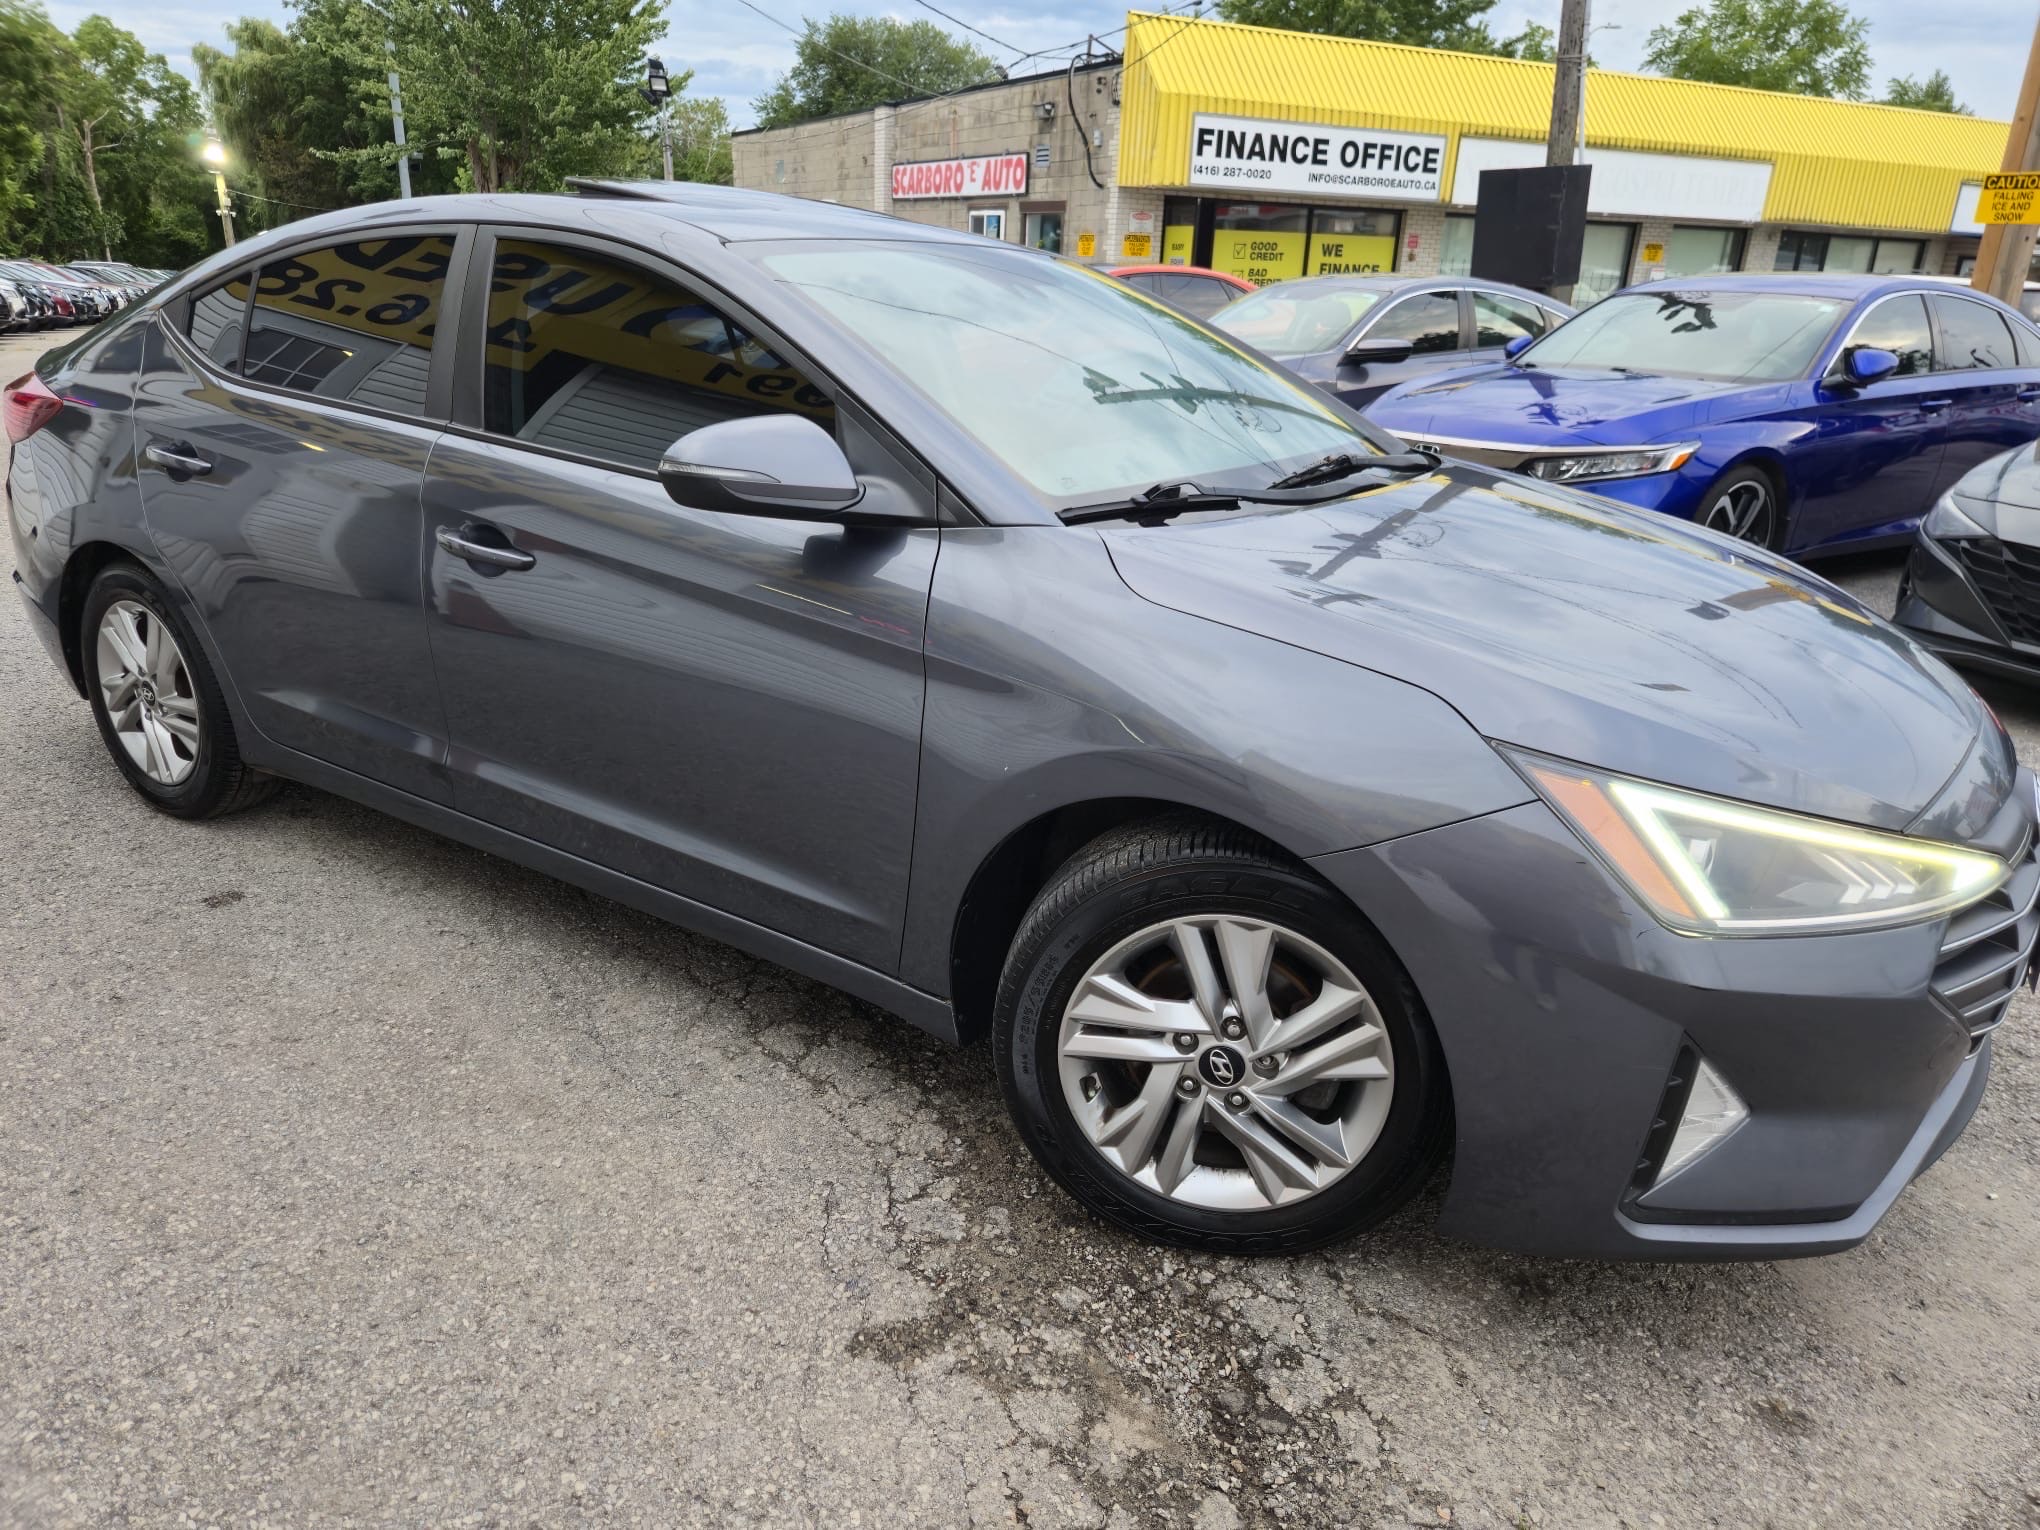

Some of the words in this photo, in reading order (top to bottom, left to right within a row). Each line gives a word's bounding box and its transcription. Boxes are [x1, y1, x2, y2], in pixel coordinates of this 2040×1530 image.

[1196, 127, 1330, 166] FINANCE
[1340, 140, 1440, 174] OFFICE
[893, 162, 964, 196] SCARBORO
[981, 156, 1025, 192] AUTO
[1193, 164, 1220, 177] (416)
[1223, 166, 1272, 180] 287-0020
[1308, 172, 1436, 191] INFO@SCARBOROEAUTO.CA
[1987, 176, 2040, 189] CAUTIO
[1992, 191, 2034, 201] FALLING
[1991, 201, 2008, 211] ICE
[2009, 201, 2031, 211] AND
[1992, 211, 2024, 222] SNOW
[1250, 241, 1278, 251] GOOD
[1321, 243, 1344, 257] WE
[1250, 252, 1284, 261] CREDIT
[1248, 268, 1268, 277] BAD
